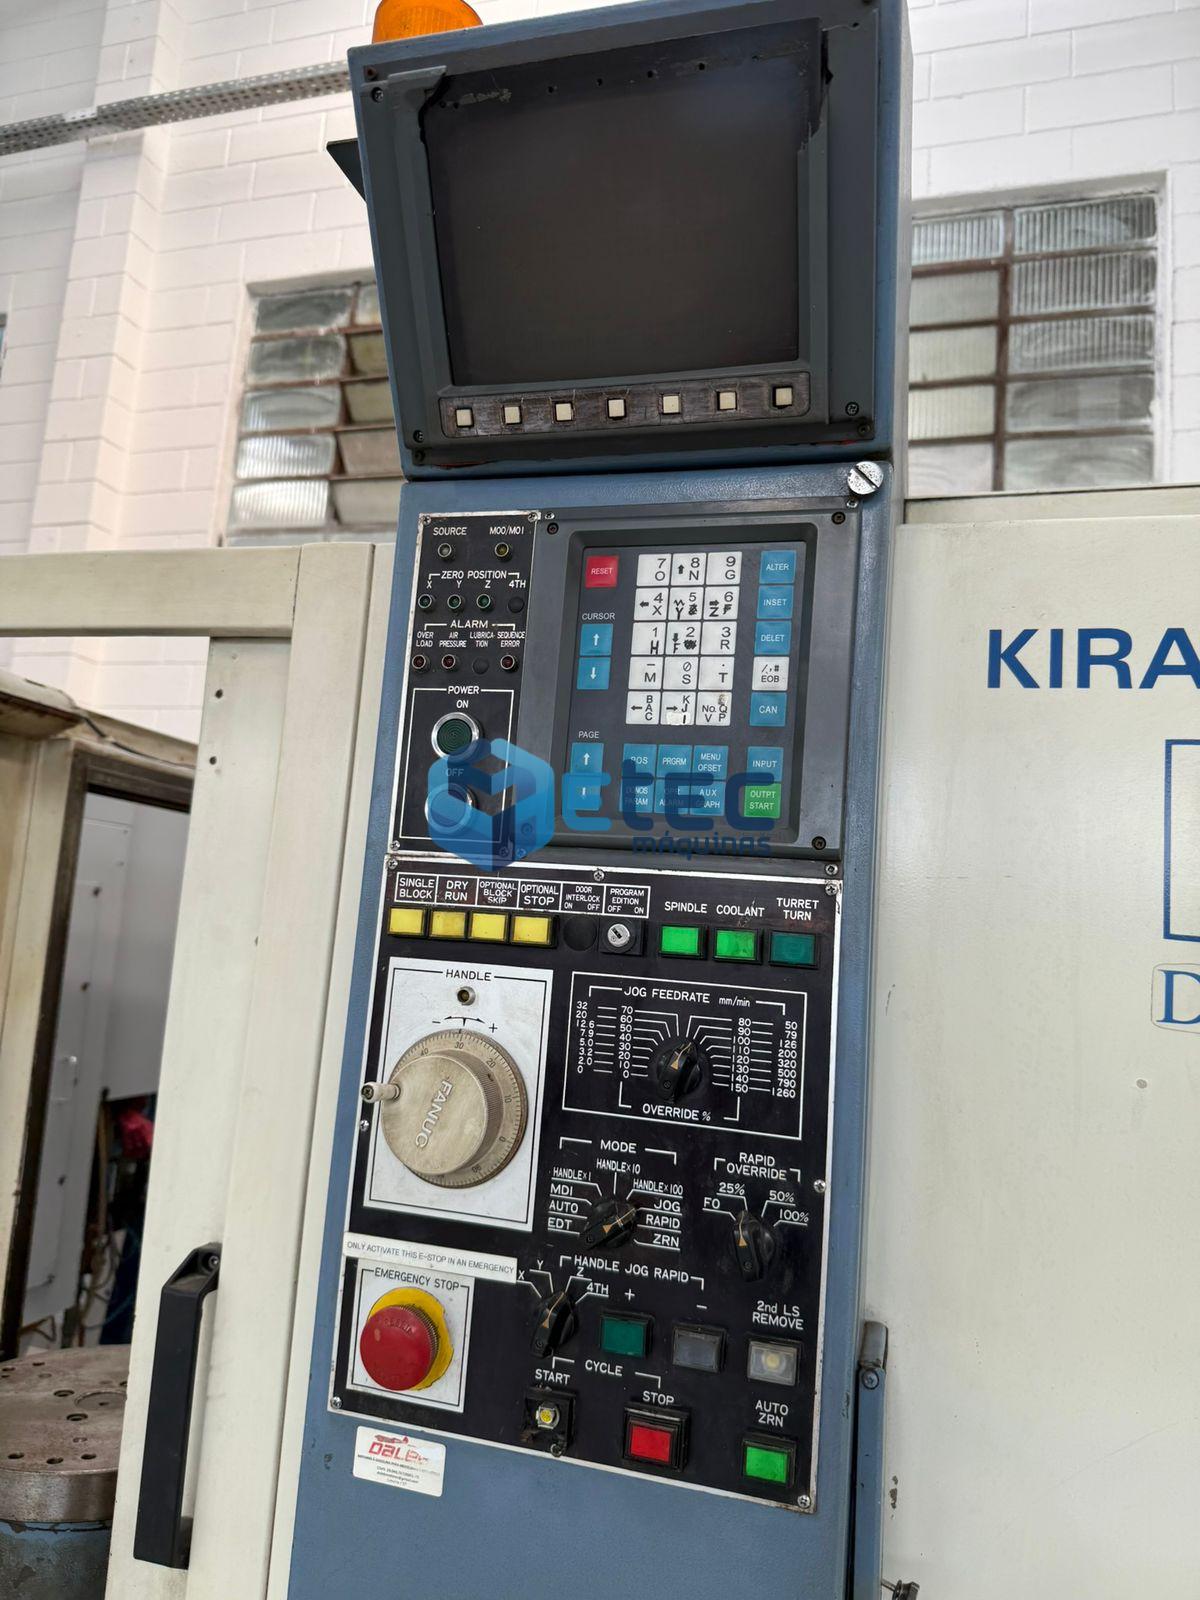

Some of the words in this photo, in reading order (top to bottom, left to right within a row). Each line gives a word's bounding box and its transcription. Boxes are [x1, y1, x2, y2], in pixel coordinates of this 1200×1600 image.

[433, 526, 467, 536] SOURCE
[657, 558, 667, 569] 7
[691, 557, 700, 569] 8
[726, 556, 736, 567] 9
[765, 562, 790, 571] ALTER
[441, 570, 464, 579] ZERO
[467, 570, 507, 579] POSITION
[590, 567, 613, 576] RESET
[689, 570, 700, 581] N
[725, 569, 736, 580] G
[508, 580, 526, 589] 4TH
[653, 592, 664, 603] 4
[689, 592, 697, 602] 5
[724, 591, 734, 603] 6
[762, 598, 787, 607] INSET
[652, 605, 663, 616] X
[582, 612, 616, 621] CURSOR
[450, 620, 488, 629] ALARM
[416, 631, 434, 639] OVER
[448, 631, 459, 639] AIR
[497, 631, 526, 639] SEQUENCE
[685, 627, 695, 638] 2
[721, 627, 731, 638] 3
[760, 634, 785, 643] DELET
[415, 640, 433, 648] LOAD
[439, 640, 467, 648] PRESSURE
[475, 640, 488, 648] TION
[500, 640, 520, 648] ERROR
[720, 639, 731, 650] R
[987, 628, 1200, 689] KIRA
[643, 672, 657, 683] M
[682, 674, 692, 685] S
[718, 672, 728, 683] T
[760, 675, 780, 683] EOB
[447, 686, 480, 695] POWER
[456, 699, 469, 709] ON
[758, 705, 778, 714] CAN
[645, 712, 653, 721] C
[578, 730, 600, 739] PAGE
[630, 756, 649, 765] POS
[662, 757, 687, 766] PRGRM
[700, 753, 721, 762] MENU
[697, 764, 722, 773] OFSET
[752, 760, 777, 769] INPUT
[445, 768, 464, 777] OFF
[699, 789, 717, 797] AUX
[750, 790, 776, 799] OUTPT
[749, 801, 774, 810] START
[399, 877, 435, 889] SINGLE
[446, 880, 468, 891] DRY
[479, 881, 517, 891] OPTIONAL
[399, 888, 433, 900] BLOCK
[483, 888, 513, 898] BLOCK
[520, 883, 559, 895] OPTIONAL
[575, 886, 593, 894] DOOR
[610, 887, 645, 897] PROGRAM
[444, 890, 468, 901] RUN
[488, 896, 507, 904] SKIP
[523, 895, 555, 906] STOP
[565, 893, 600, 903] INTERLOCK
[612, 896, 640, 905] EDITION
[564, 902, 573, 910] ON
[587, 903, 600, 911] OFF
[664, 900, 708, 914] SPINDLE
[776, 895, 820, 911] TURRET
[608, 905, 622, 913] OFF
[634, 906, 645, 914] ON
[716, 904, 765, 918] COOLANT
[782, 909, 812, 922] TURN
[446, 969, 492, 982] HANDLE
[623, 985, 648, 998] JOG
[651, 988, 711, 1004] FEEDRATE
[718, 996, 751, 1008] mm/min
[576, 1001, 588, 1010] 32
[621, 1005, 634, 1015] 70
[575, 1010, 588, 1019] 20
[620, 1014, 633, 1024] 60
[576, 1018, 595, 1029] 12.6
[738, 1017, 752, 1027] 80
[785, 1021, 798, 1031] 50
[580, 1028, 595, 1038] 7.9
[619, 1024, 633, 1033] 50
[737, 1027, 751, 1037] 90
[619, 1032, 632, 1042] 40
[785, 1030, 798, 1040] 79
[454, 1041, 465, 1050] 30
[579, 1036, 594, 1047] 5.0
[618, 1041, 632, 1051] 30
[732, 1036, 751, 1046] 100
[780, 1039, 797, 1050] 126
[578, 1046, 593, 1056] 3.2
[732, 1045, 750, 1056] 110
[778, 1049, 798, 1059] 200
[577, 1056, 593, 1066] 2.0
[618, 1051, 631, 1061] 20
[731, 1055, 750, 1065] 120
[485, 1057, 496, 1069] 20
[619, 1060, 631, 1070] 10
[777, 1058, 797, 1069] 320
[576, 1064, 583, 1074] 0
[622, 1069, 630, 1079] 0
[731, 1064, 750, 1074] 130
[777, 1068, 796, 1079] 500
[731, 1073, 749, 1084] 140
[776, 1078, 796, 1089] 790
[730, 1083, 749, 1094] 150
[771, 1086, 796, 1099] 1260
[415, 1079, 453, 1149] FANUC
[642, 1103, 700, 1121] OVERRIDE
[600, 1138, 637, 1154] MODE
[739, 1152, 775, 1168] RAPID
[726, 1162, 787, 1181] OVERRIDE
[550, 1183, 573, 1197] MDI
[719, 1182, 746, 1196] 25%
[769, 1190, 795, 1203] 50%
[549, 1200, 579, 1214] AUTO
[653, 1199, 681, 1212] JOG
[779, 1208, 809, 1223] 100%
[548, 1217, 572, 1231] EDT
[645, 1214, 681, 1229] RAPID
[652, 1233, 680, 1248] ZRN
[347, 1241, 366, 1250] ONLY
[366, 1244, 400, 1256] ACTIVATE
[402, 1249, 418, 1260] THIS
[447, 1256, 455, 1264] IN
[456, 1257, 467, 1267] AN
[468, 1259, 515, 1274] EMERGENCY
[574, 1254, 620, 1271] HANDLE
[625, 1264, 649, 1277] JOG
[654, 1267, 689, 1283] RAPID
[374, 1267, 431, 1286] EMERGENCY
[434, 1277, 460, 1290] STOP
[586, 1281, 609, 1295] 4TH
[757, 1300, 778, 1315] 2nd
[784, 1303, 800, 1318] LS
[752, 1311, 804, 1331] REMOVE
[585, 1359, 623, 1377] CYCLE
[535, 1368, 570, 1385] START
[642, 1390, 674, 1406] STOP
[755, 1399, 789, 1416] AUTO
[758, 1412, 784, 1428] ZRN
